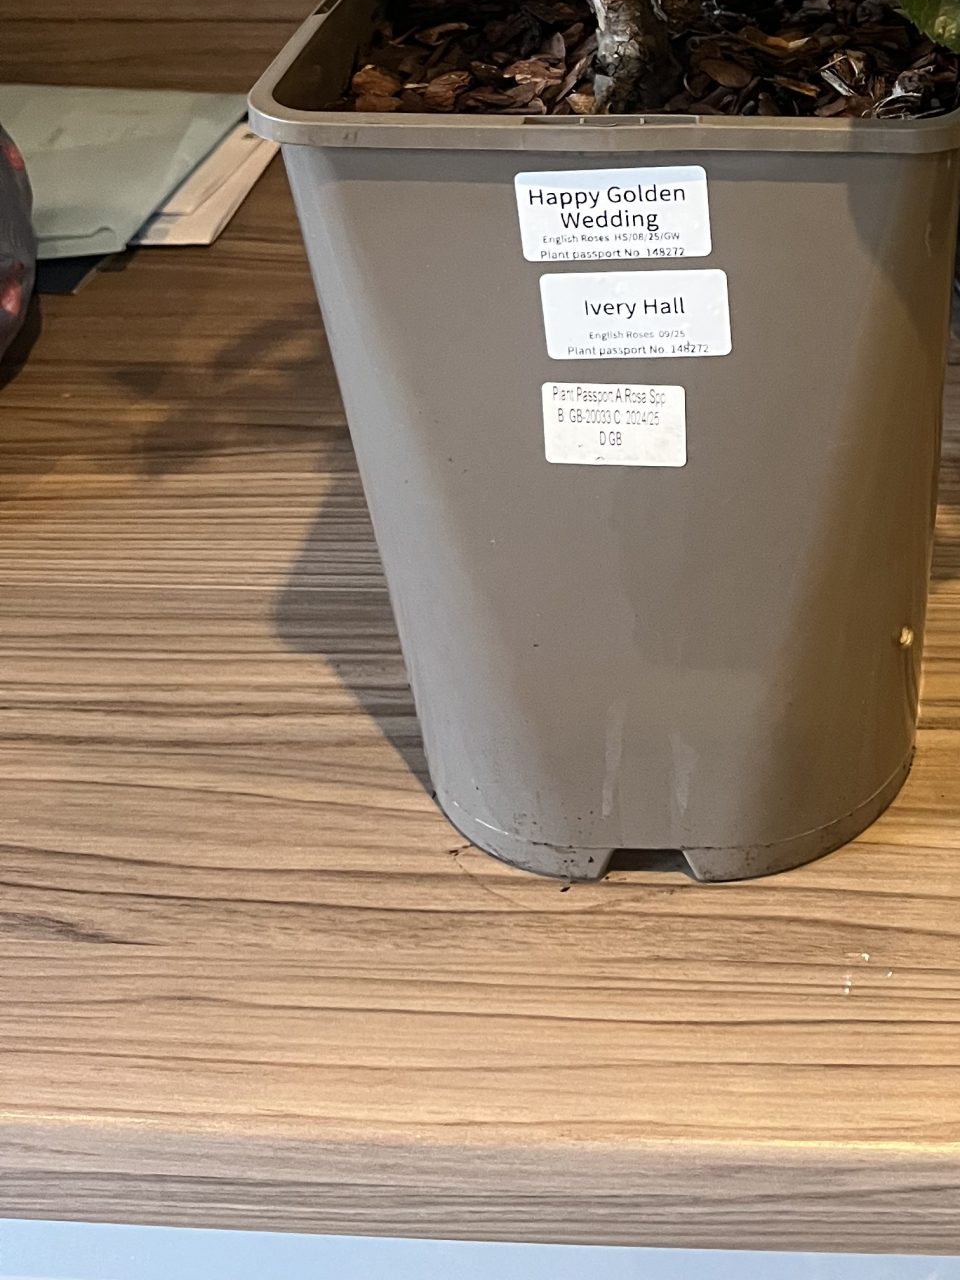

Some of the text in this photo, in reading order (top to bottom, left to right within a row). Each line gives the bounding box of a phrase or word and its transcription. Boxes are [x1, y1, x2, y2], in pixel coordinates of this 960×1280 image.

[528, 184, 686, 210] Happy Golden
[560, 210, 660, 231] Wedding
[542, 234, 579, 245] English
[581, 233, 610, 243] Roses
[540, 250, 570, 260] Plant
[572, 249, 622, 260] passport
[646, 247, 686, 257] 148272
[584, 297, 686, 320] Ivery Hall
[589, 330, 686, 341] English Roses 09/25
[567, 346, 597, 356] Plant
[599, 345, 647, 357] passport
[671, 343, 710, 354] 148272
[625, 410, 660, 426] 2024/25
